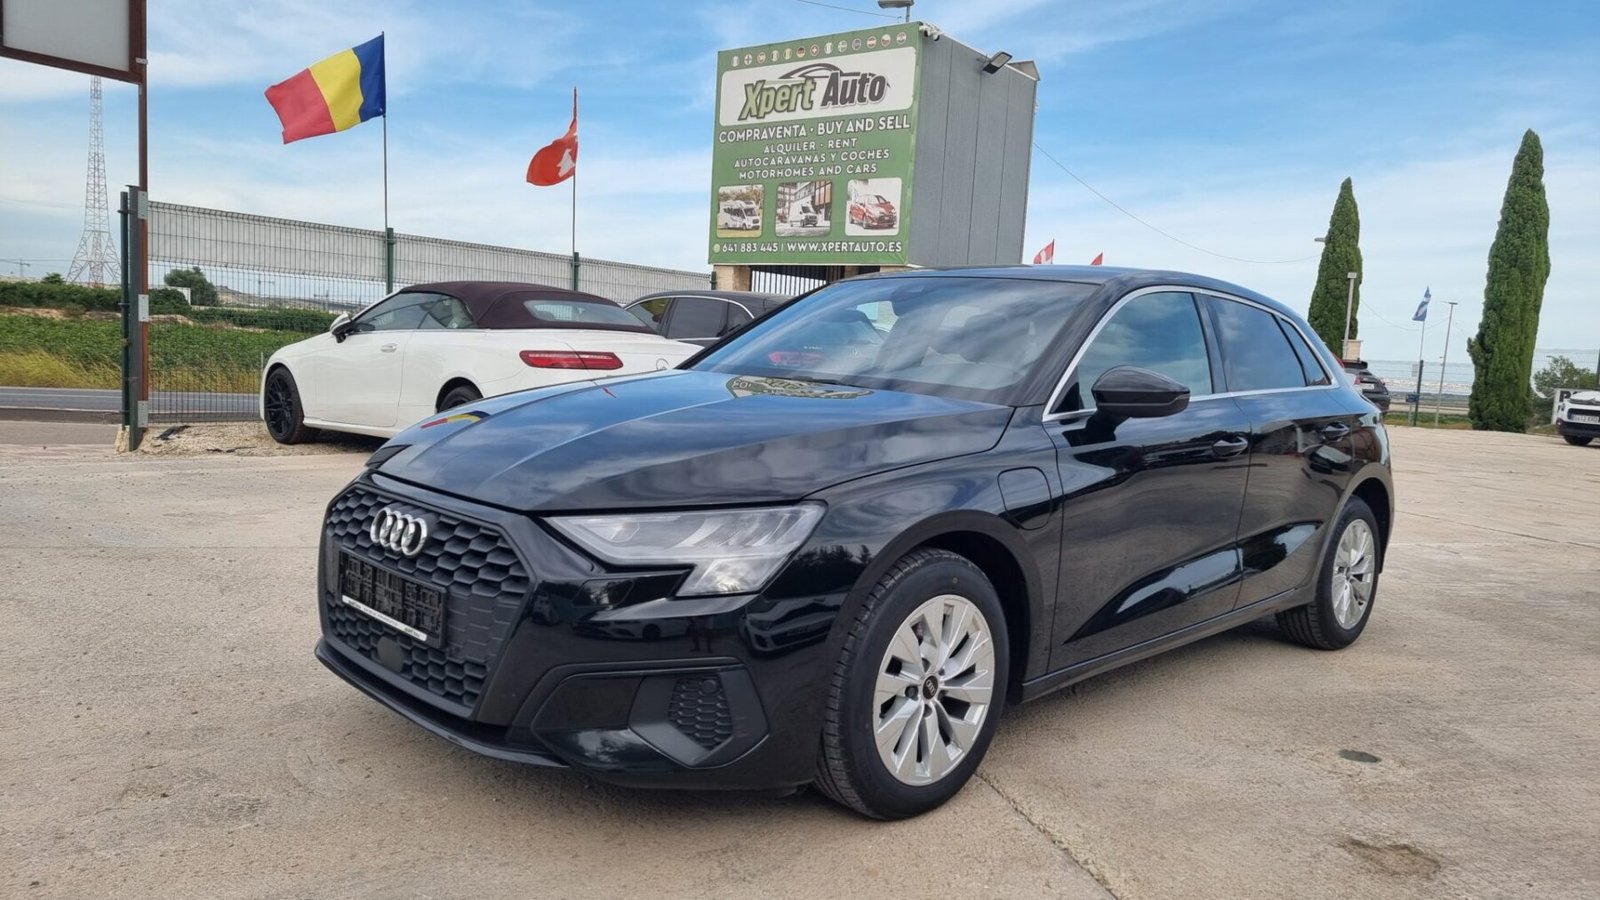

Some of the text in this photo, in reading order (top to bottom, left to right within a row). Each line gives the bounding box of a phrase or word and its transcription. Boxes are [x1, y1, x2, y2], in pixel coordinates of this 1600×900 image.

[738, 72, 887, 120] Xpert Auto
[719, 115, 910, 143] COMPRAVENTA BUY AND SELL
[764, 138, 857, 154] ALQUILER RENT
[734, 149, 890, 168] AUTOCARAVANAS Y COCHES
[739, 163, 877, 180] MOTORHOMES AND CARS
[722, 241, 902, 253] 641 883 445 WWW.XPERTAUTO.ES
